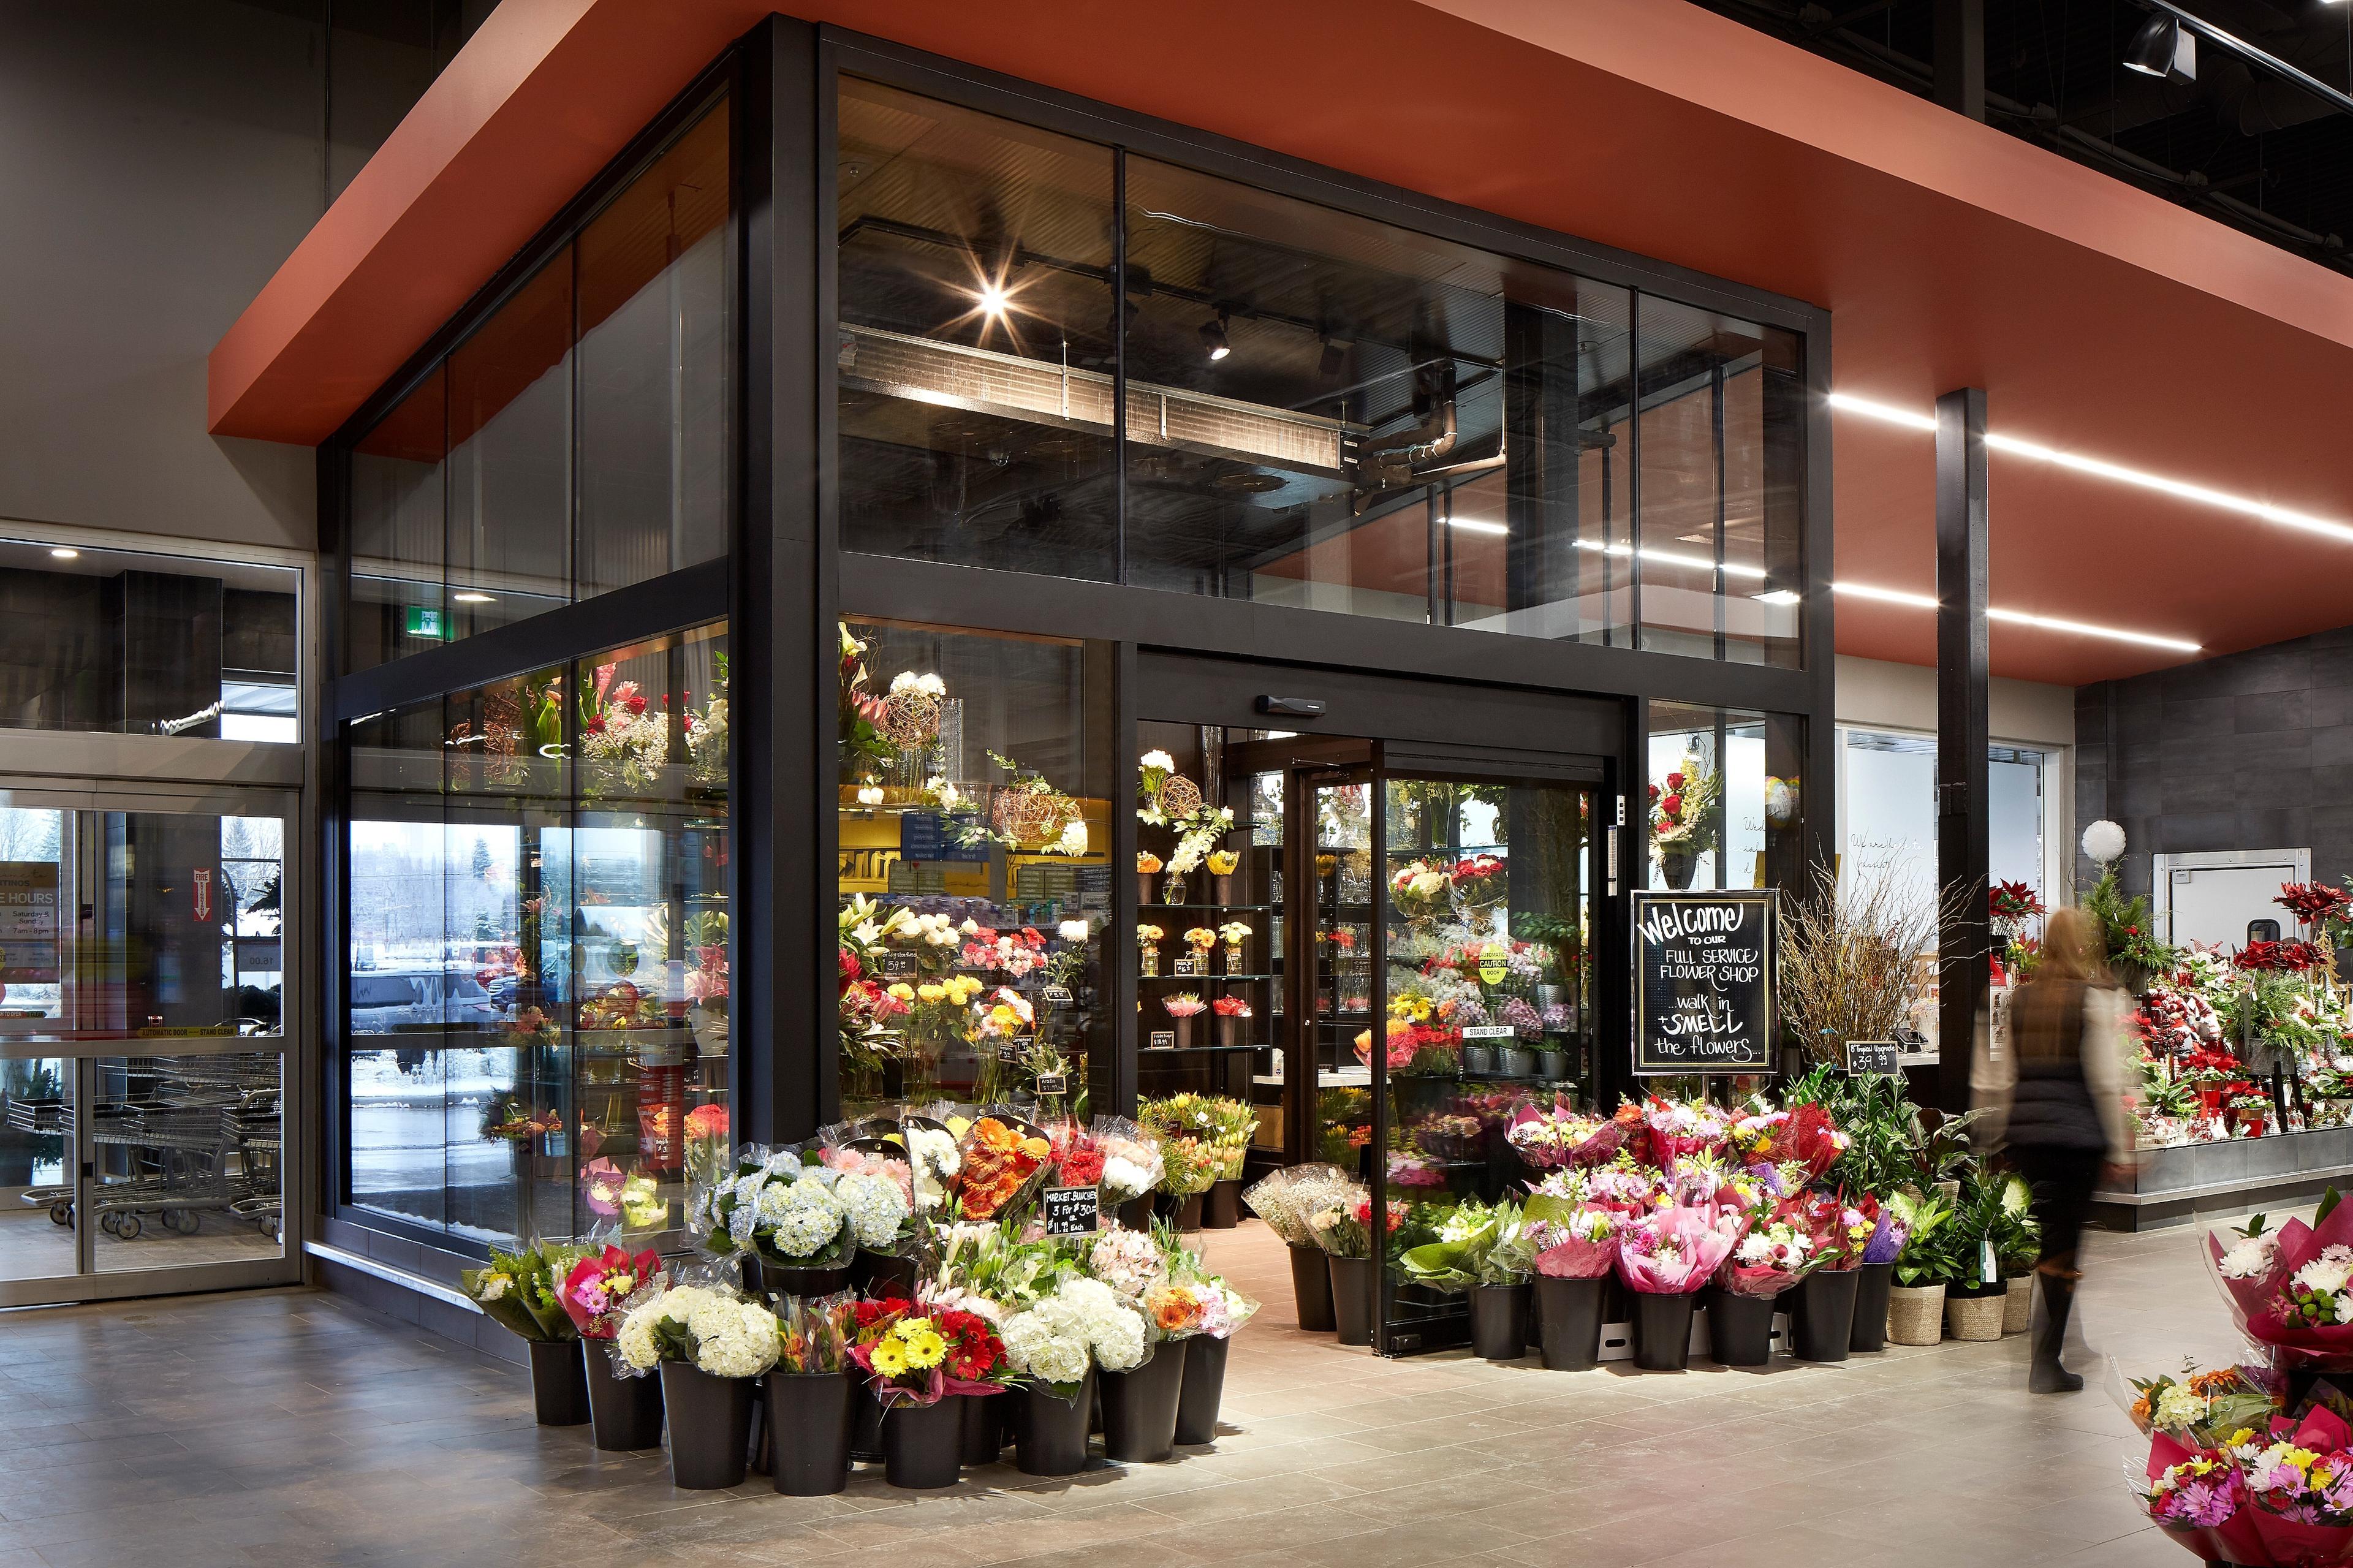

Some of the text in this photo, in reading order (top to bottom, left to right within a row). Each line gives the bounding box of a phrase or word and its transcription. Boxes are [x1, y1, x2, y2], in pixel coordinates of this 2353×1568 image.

[9, 893, 53, 904] HOURS
[1637, 903, 1744, 946] Welcome
[1688, 935, 1726, 945] TO OUR
[1665, 949, 1759, 964] FULL SERVICE
[1718, 966, 1759, 983] SHOP
[1718, 996, 1735, 1012] in
[1662, 1012, 1744, 1036] SMELL
[1654, 1037, 1686, 1056] the
[1874, 1043, 1896, 1055] Upgrade
[1046, 1191, 1072, 1203] MARKET
[1052, 1205, 1060, 1216] 3
